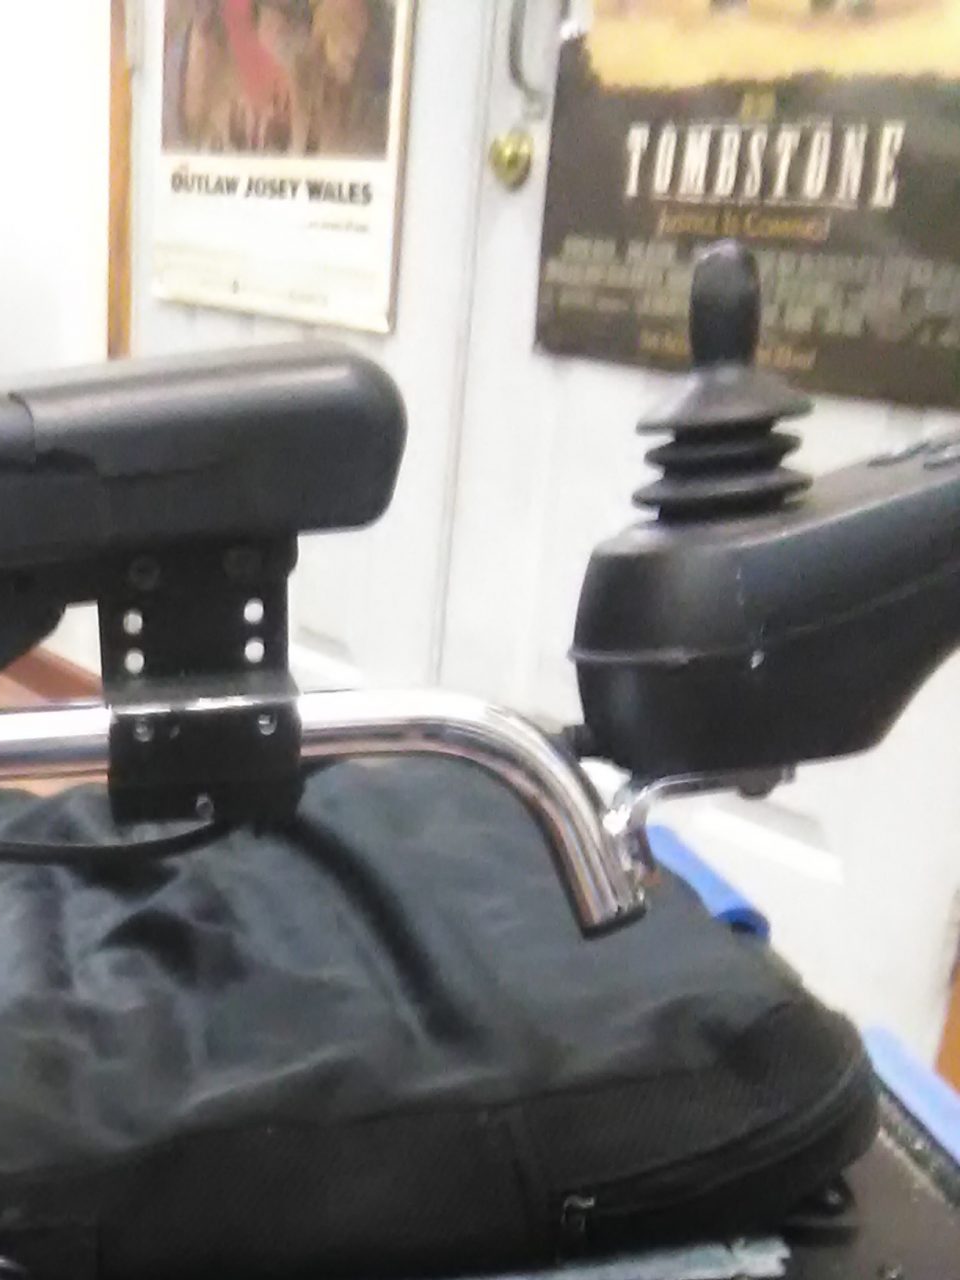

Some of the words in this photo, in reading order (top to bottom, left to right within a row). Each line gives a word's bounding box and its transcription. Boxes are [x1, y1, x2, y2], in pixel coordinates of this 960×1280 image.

[170, 171, 240, 196] OUTLAW
[304, 177, 373, 206] WALES
[624, 119, 907, 210] TOMBSTONE
